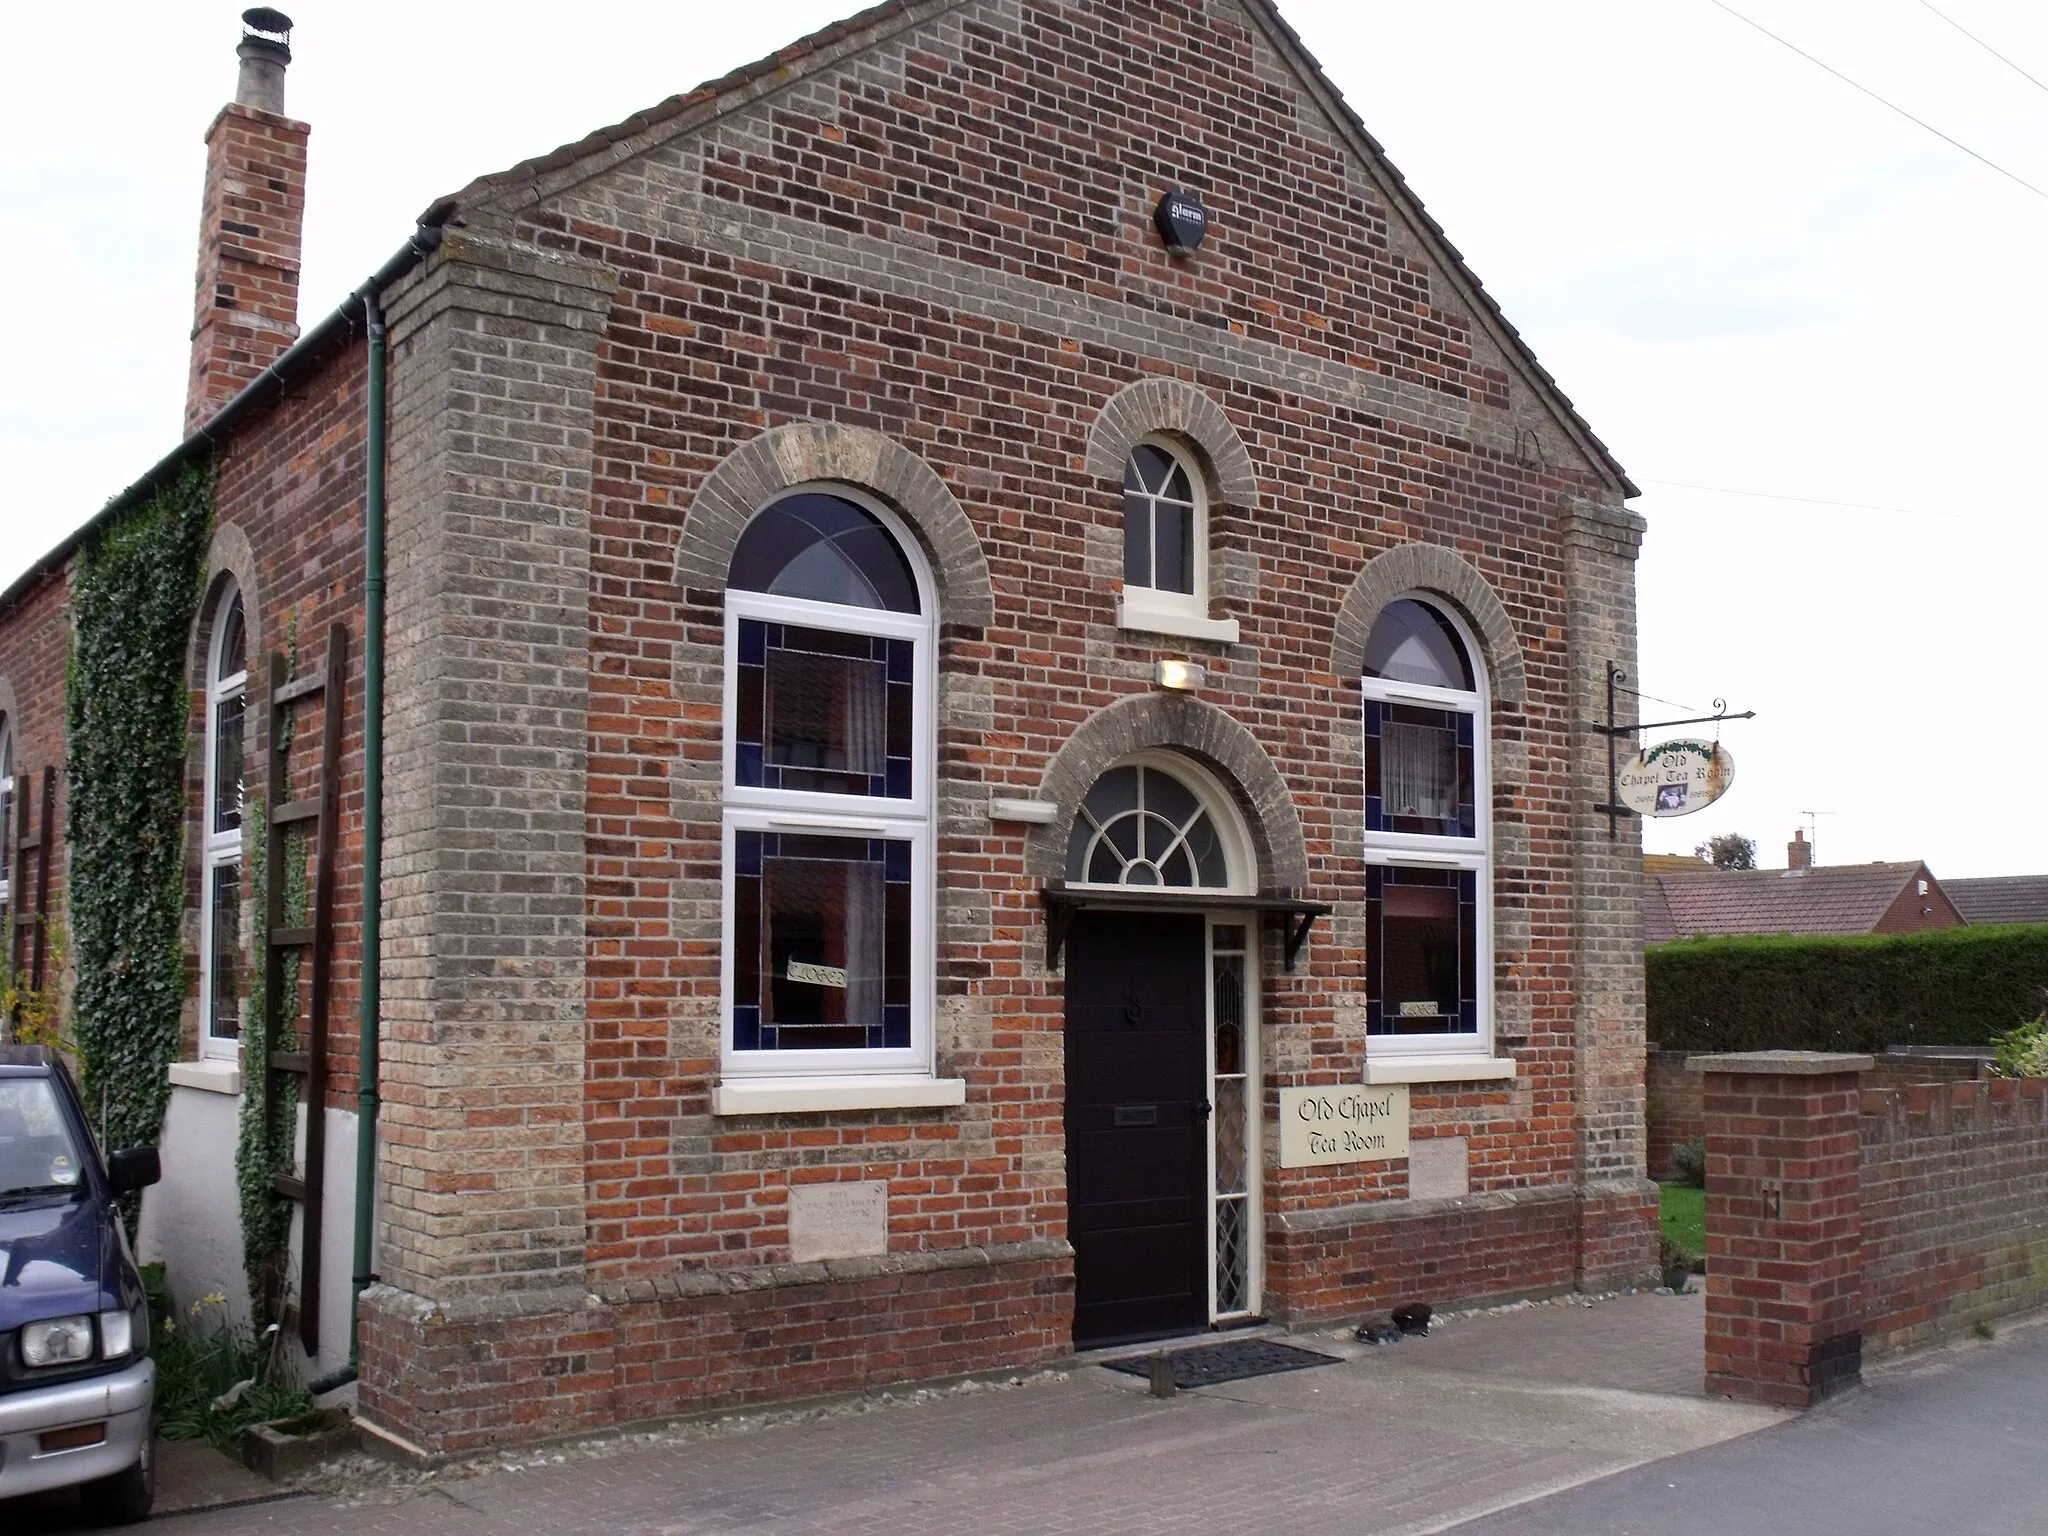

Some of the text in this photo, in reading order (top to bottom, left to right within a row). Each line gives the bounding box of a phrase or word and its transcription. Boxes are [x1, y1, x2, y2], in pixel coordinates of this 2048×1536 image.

[1662, 754, 1687, 768] Old
[1621, 767, 1730, 786] Chapel Tea Room
[1298, 1093, 1394, 1125] Old Chapel
[1308, 1130, 1385, 1154] Tea Room
